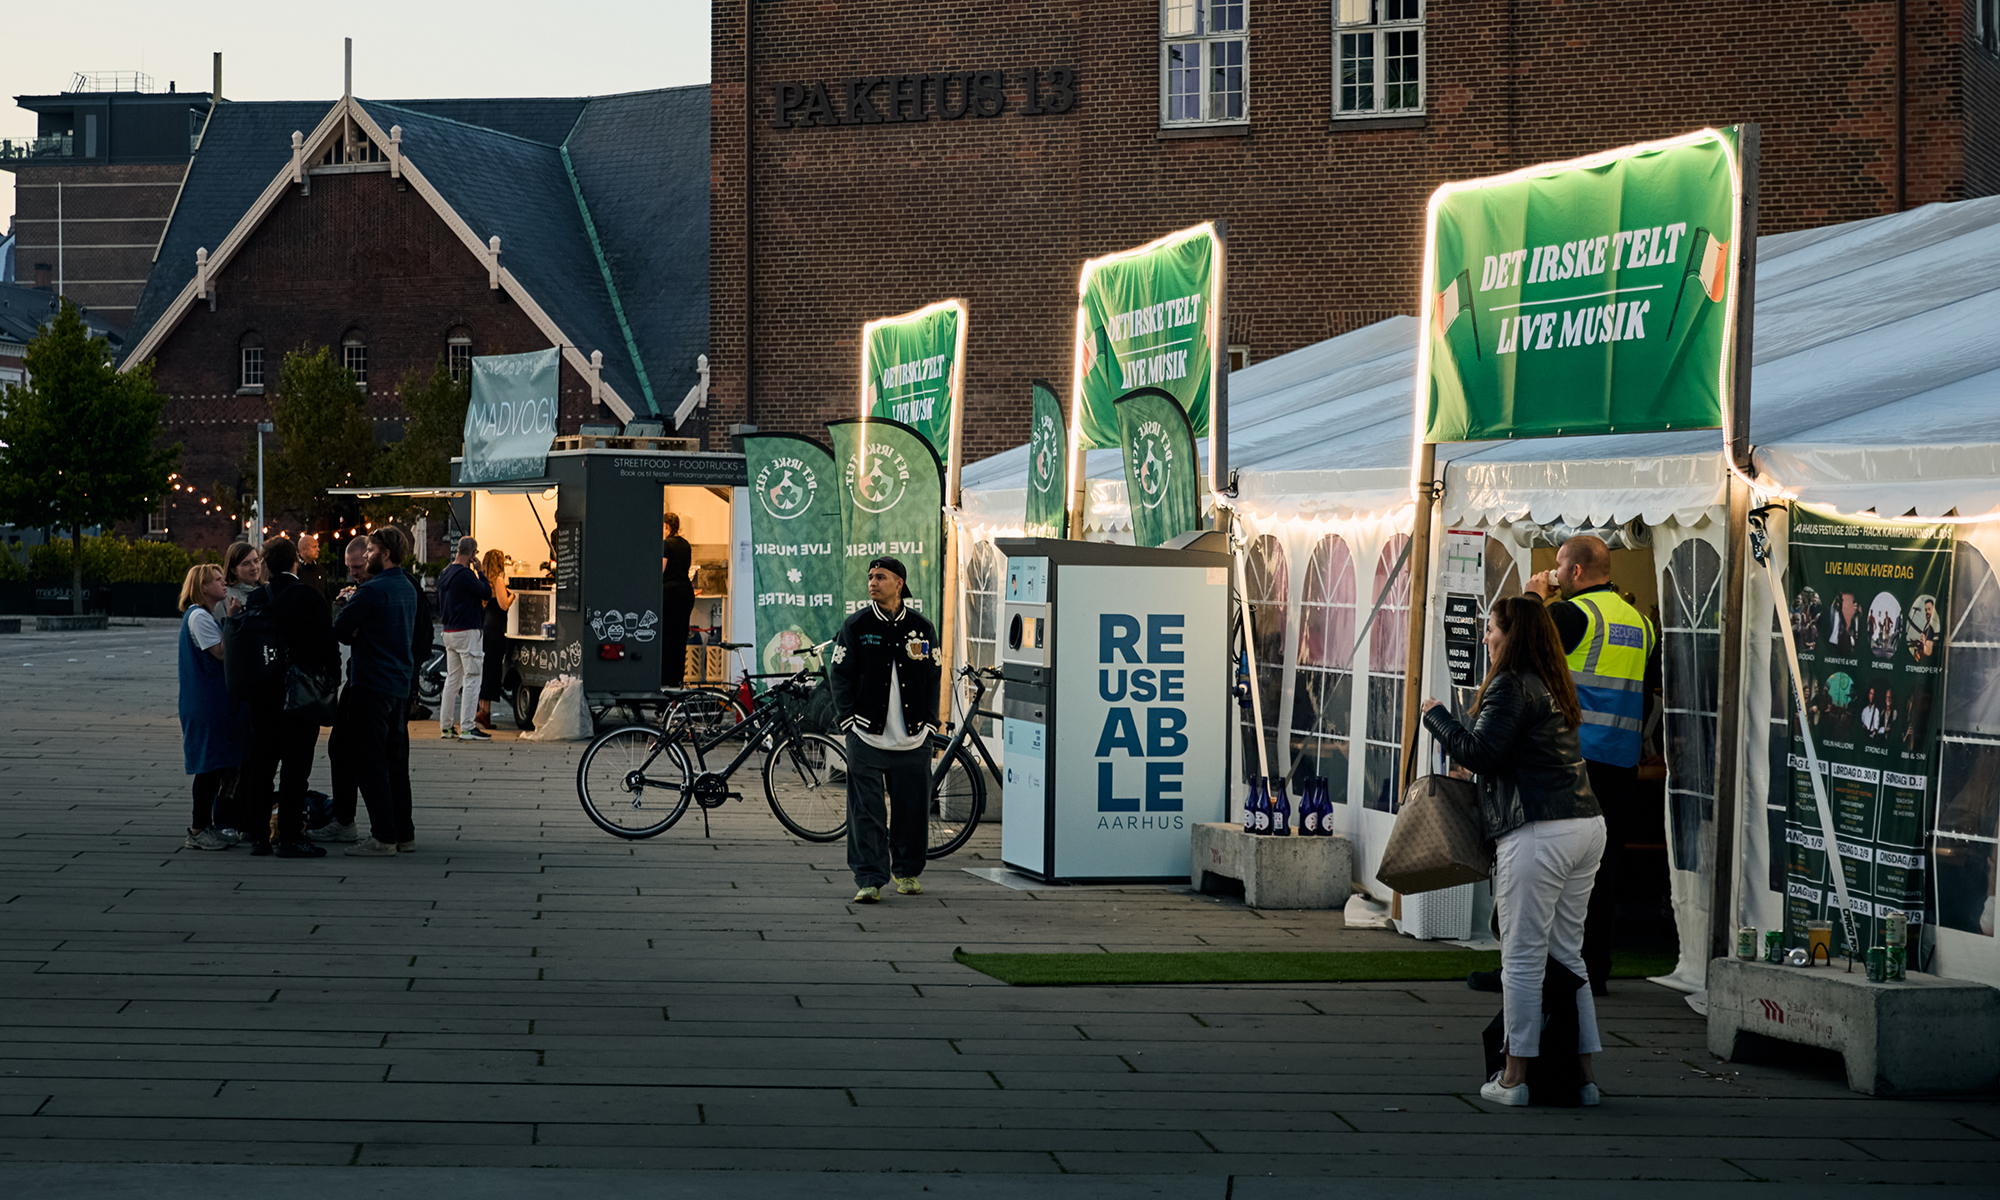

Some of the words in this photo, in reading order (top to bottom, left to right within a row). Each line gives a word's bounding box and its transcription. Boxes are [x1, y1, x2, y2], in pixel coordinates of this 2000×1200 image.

[772, 69, 1004, 128] PAKHUS
[1019, 65, 1074, 115] 13
[1479, 249, 1527, 292] DET
[1526, 235, 1609, 284] IRSKE
[1612, 222, 1687, 271] TELT
[1108, 313, 1130, 343] DET
[1129, 302, 1164, 338] IRSKE
[1165, 293, 1201, 329] TELT
[1496, 312, 1557, 354] LIVE
[1557, 300, 1650, 348] MUSIK
[883, 366, 899, 389] DET
[1121, 358, 1146, 389] LIVE
[1147, 349, 1188, 385] MUSIK
[892, 402, 909, 424] LIVE
[614, 458, 671, 469] STREETFOOD
[680, 460, 739, 471] FOODTRUCKS
[620, 469, 635, 477] Book
[1819, 525, 1844, 536] FESTUGE
[1845, 526, 1859, 536] 2025
[1863, 526, 1882, 537] HACK
[1825, 561, 1842, 575] LIVE
[1843, 563, 1869, 576] MUSIK
[1870, 564, 1893, 578] HVER
[1894, 566, 1914, 579] DAG
[1099, 614, 1185, 664] RE
[1451, 627, 1470, 636] UDEFRA
[1610, 625, 1642, 640] SECURITY
[1449, 649, 1459, 657] MAD
[1460, 650, 1469, 658] FRA
[1099, 669, 1184, 702] USE
[1094, 707, 1188, 757] AB
[1833, 765, 1856, 778] LØRDAG
[1864, 769, 1878, 781] 30/8
[1098, 762, 1184, 812] LE
[1097, 816, 1184, 829] AARHUS
[1811, 837, 1823, 849] 1/9
[1843, 908, 1855, 936] CARGO
